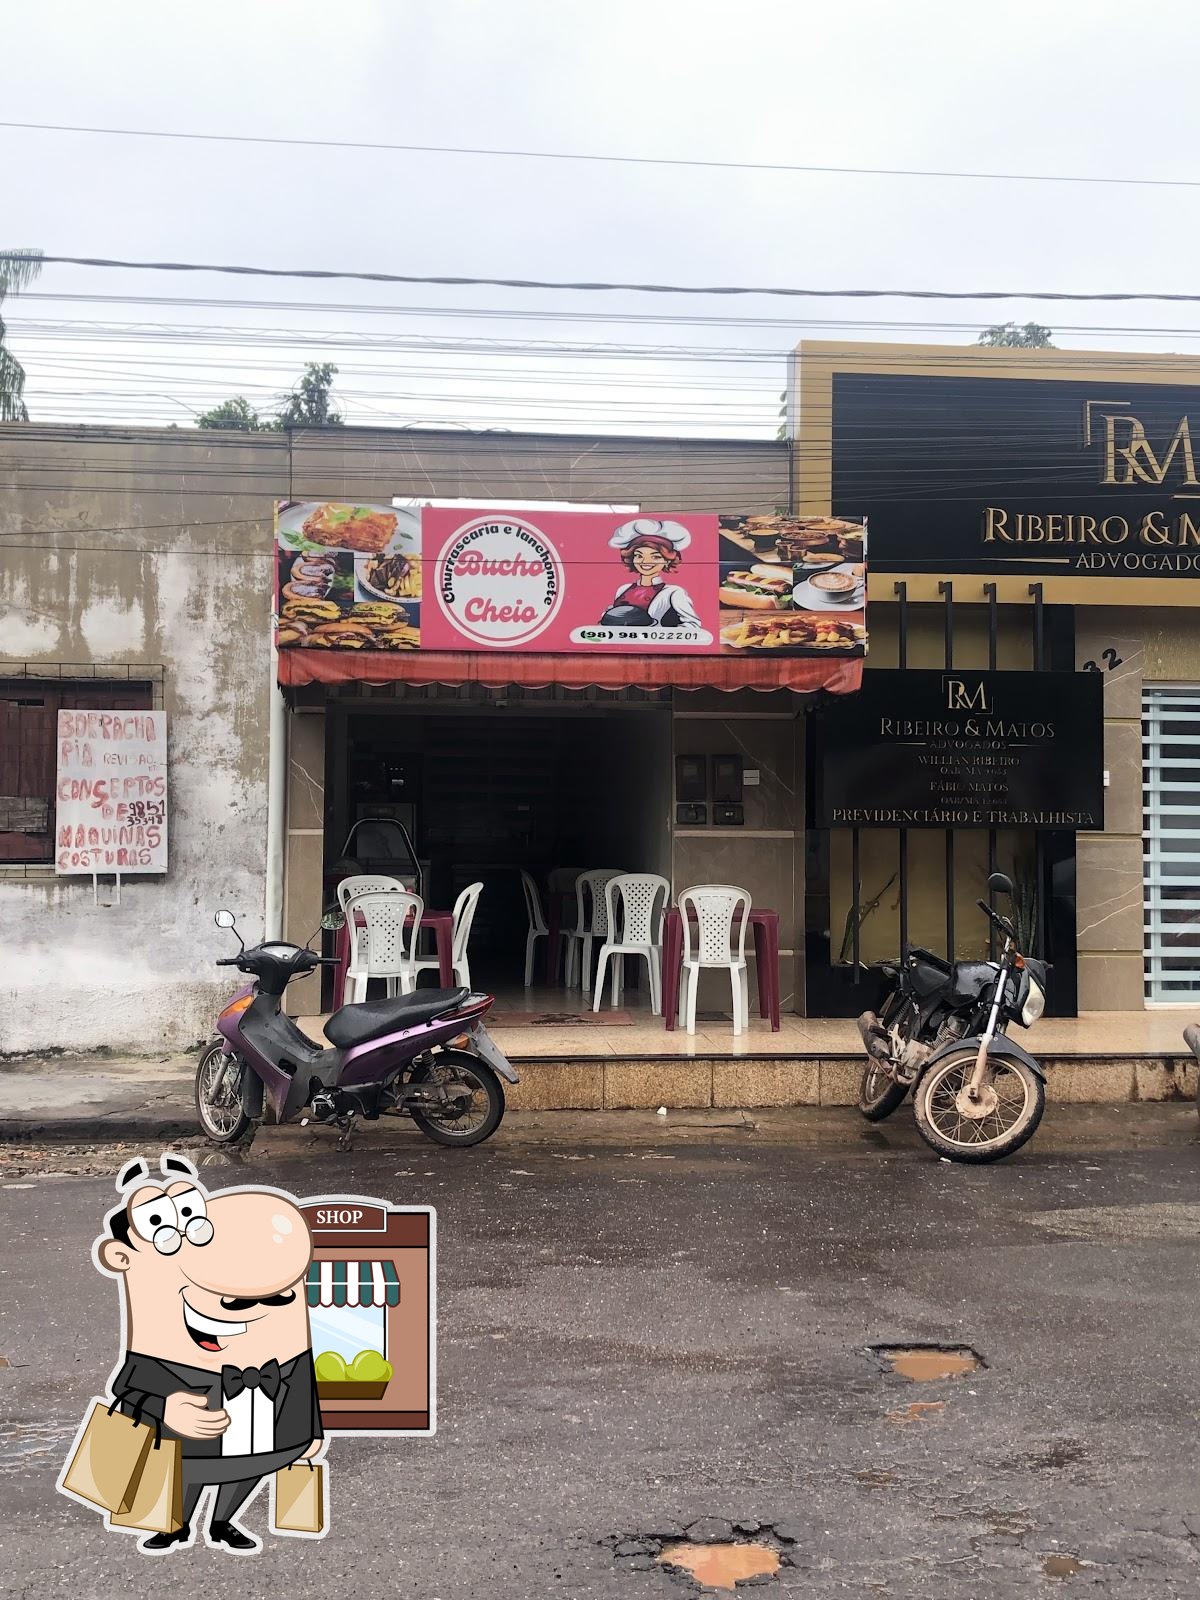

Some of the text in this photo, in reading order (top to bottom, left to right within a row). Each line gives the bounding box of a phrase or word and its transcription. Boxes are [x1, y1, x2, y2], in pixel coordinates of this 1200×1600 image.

[982, 506, 1129, 544] RIBEIRO
[443, 523, 499, 604] Churrascaria
[454, 550, 545, 577] Bucho
[464, 597, 538, 624] Cheio
[580, 630, 613, 640] (98)
[880, 717, 960, 736] RIBEIRO
[986, 721, 1056, 738] MATOS
[930, 740, 1007, 751] ADVOGADOS
[968, 782, 1009, 792] MATOS
[832, 807, 1096, 825] PREVIDENCIÁRIO E TRABALHISTA
